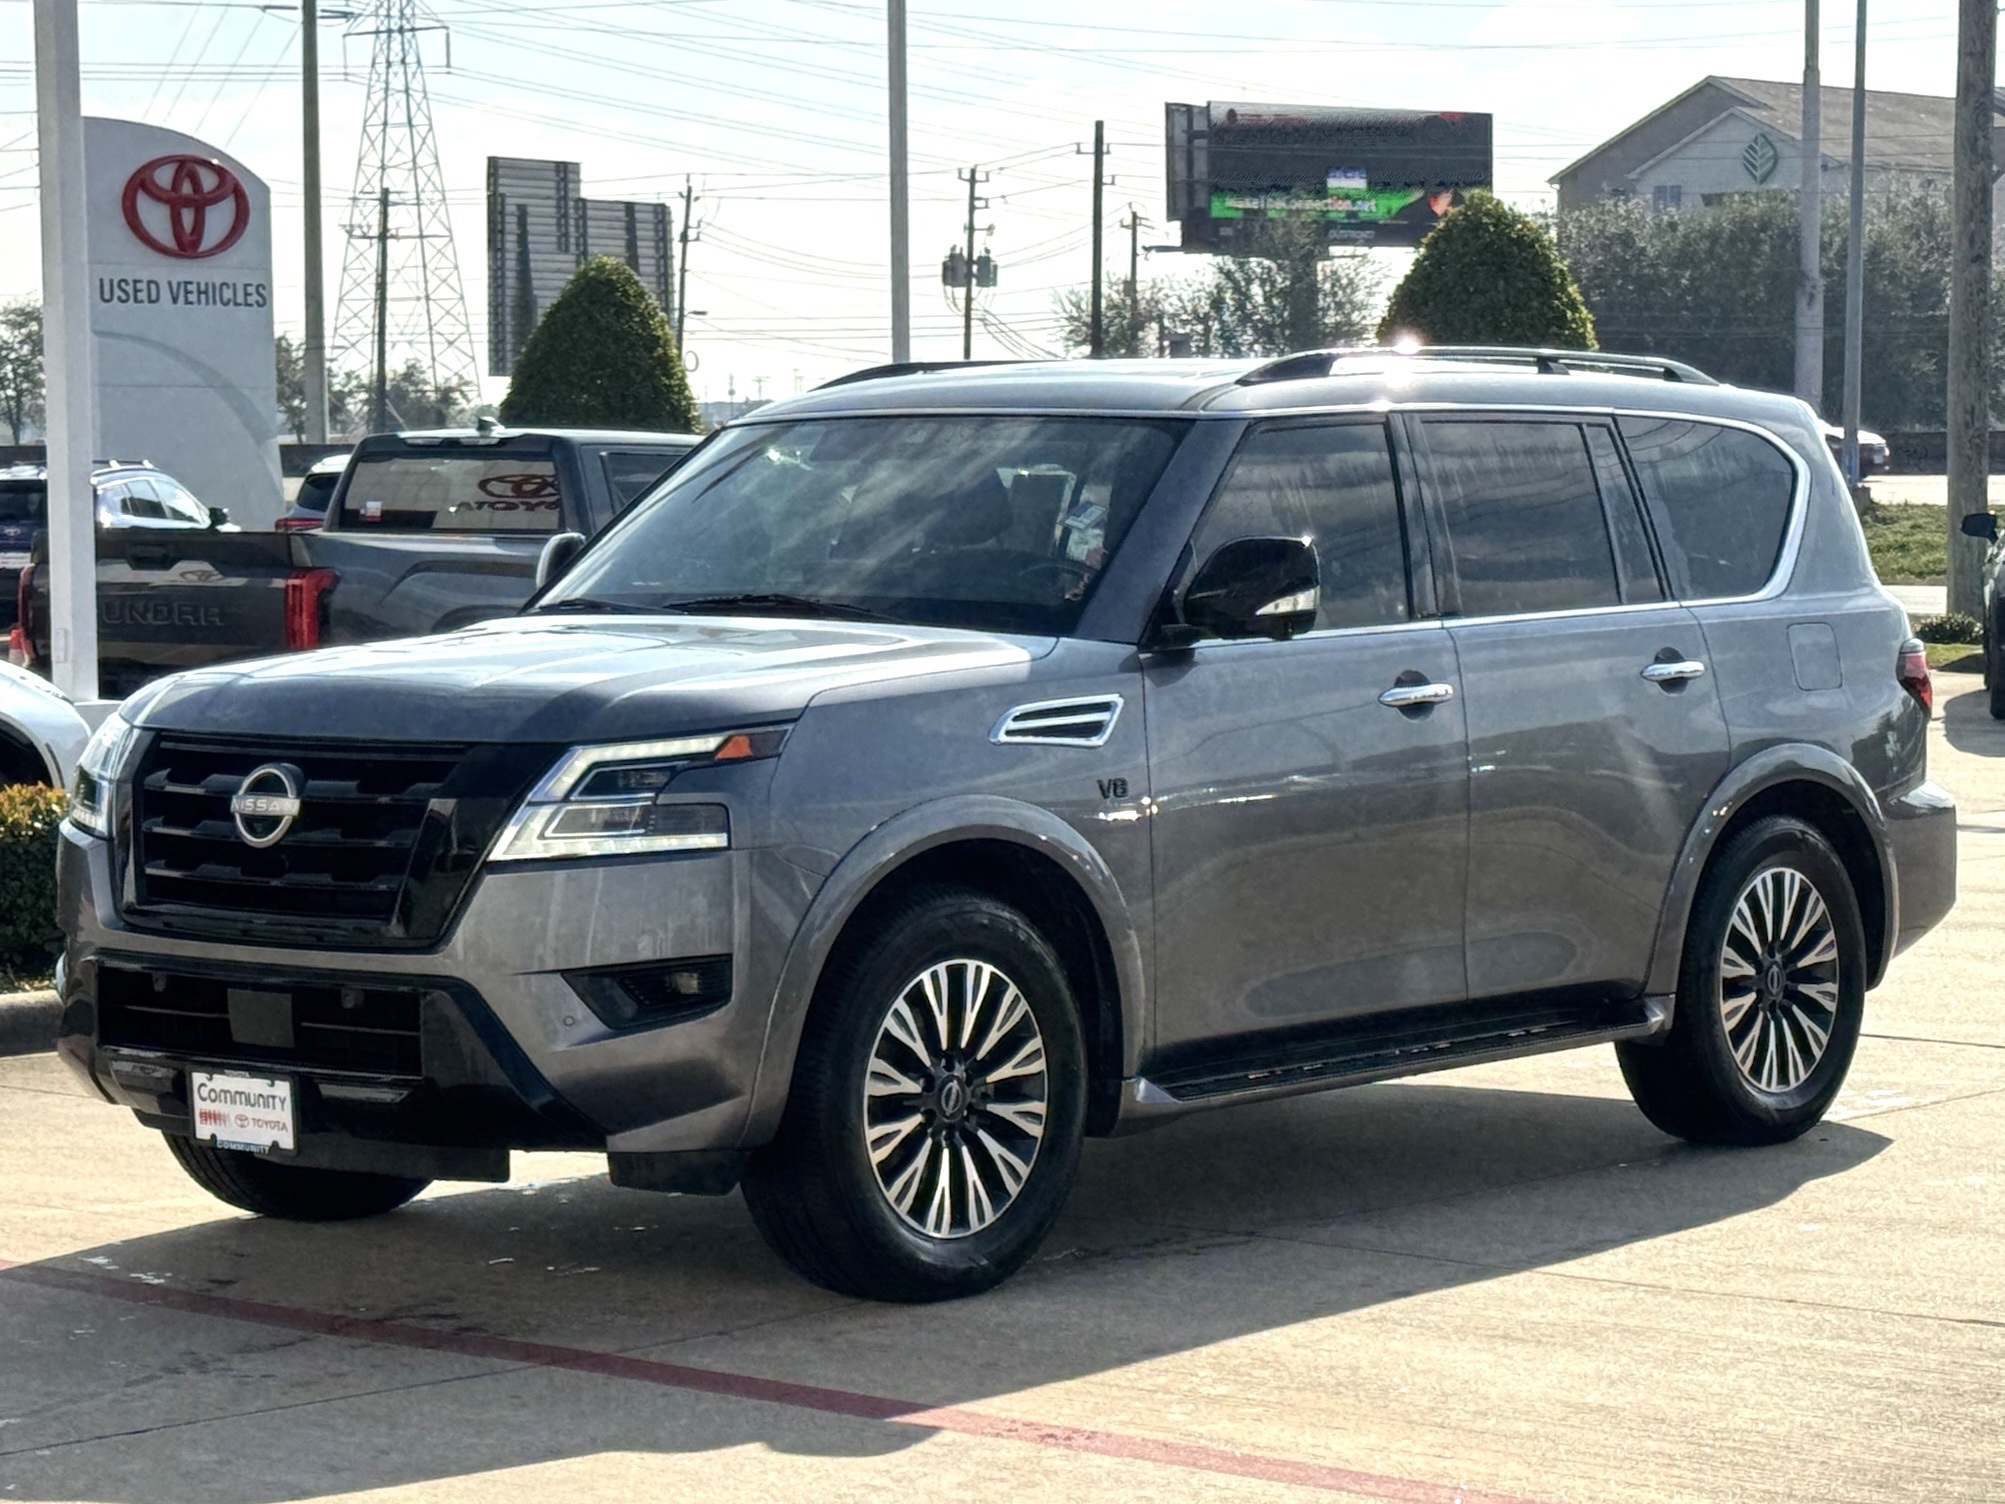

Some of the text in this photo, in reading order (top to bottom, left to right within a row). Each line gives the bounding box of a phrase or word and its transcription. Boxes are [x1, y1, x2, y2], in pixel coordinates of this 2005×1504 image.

[98, 277, 268, 309] USED VEHICLES
[102, 599, 226, 627] UNDRA
[230, 796, 299, 815] NISSAN
[250, 1117, 289, 1133] TOYOTA
[216, 1140, 270, 1155] COMMUNITY
